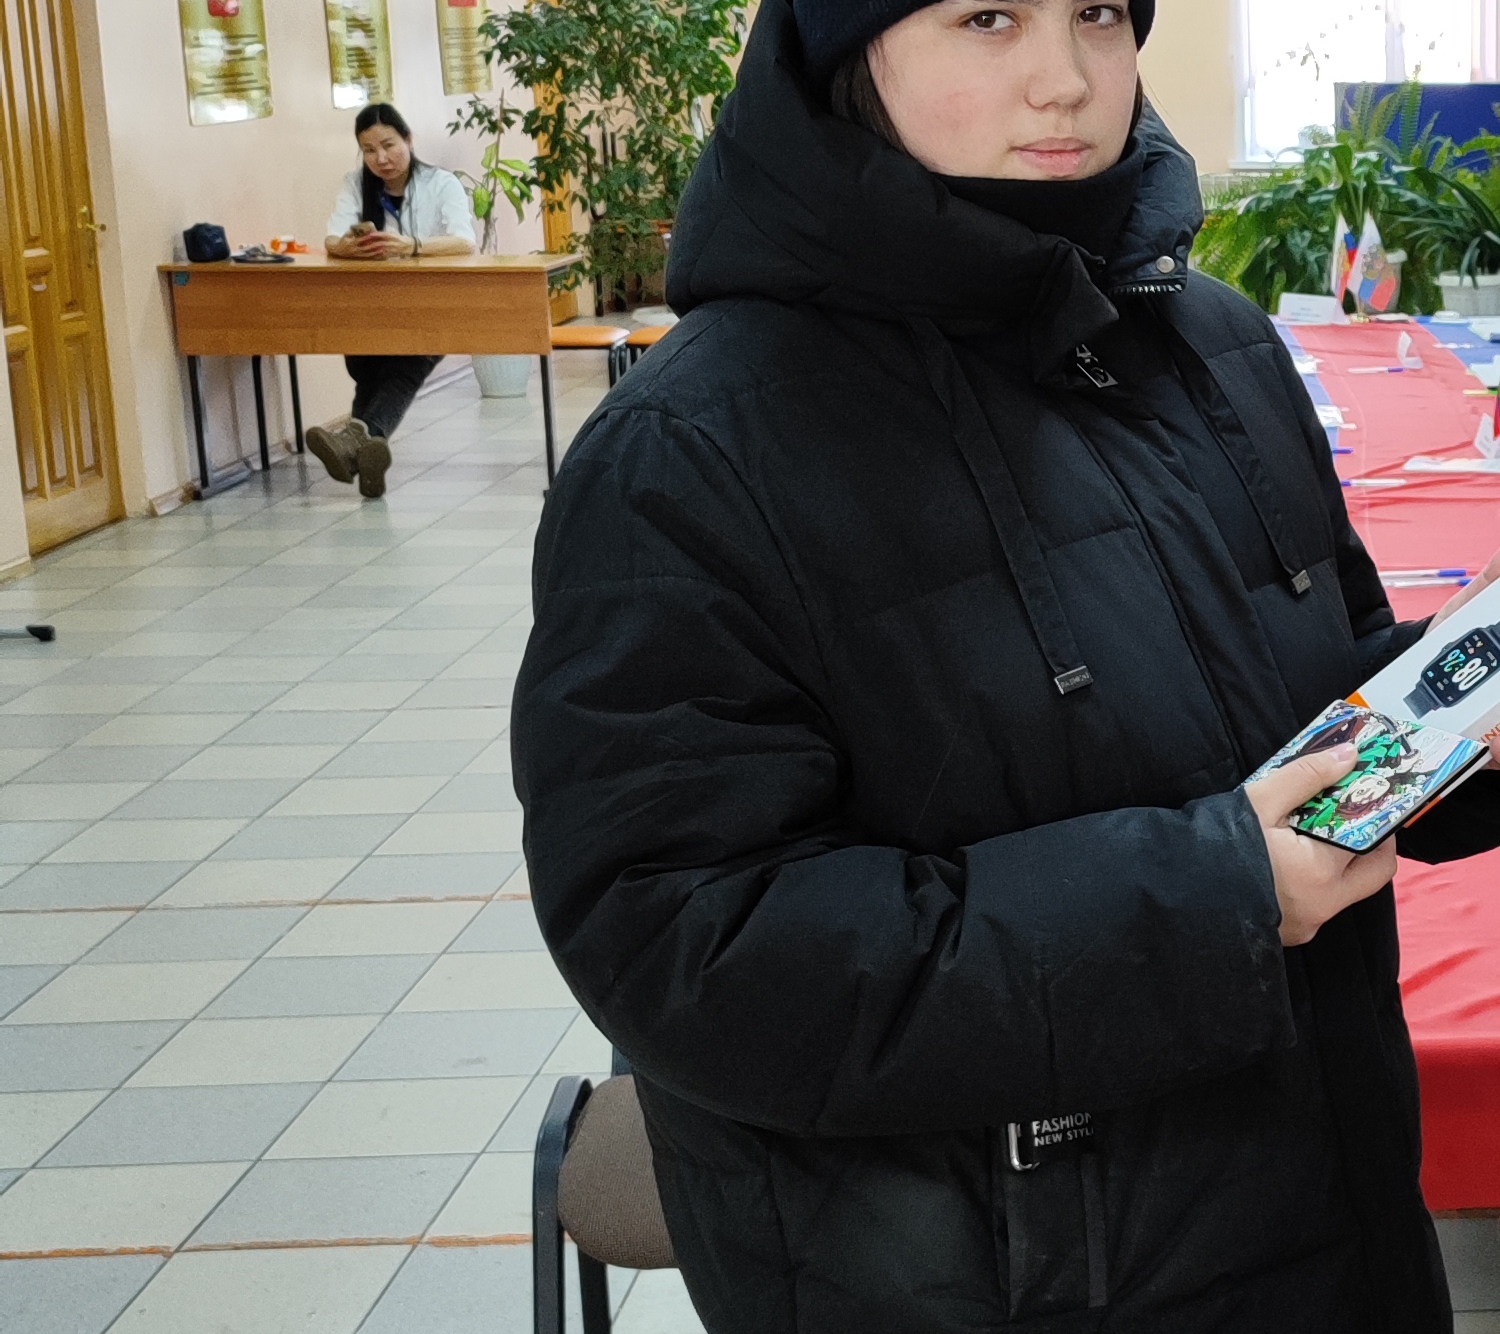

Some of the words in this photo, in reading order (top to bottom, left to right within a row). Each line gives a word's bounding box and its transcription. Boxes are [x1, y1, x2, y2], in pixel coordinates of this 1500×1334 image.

[1031, 1112, 1092, 1135] FASHION
[1034, 1132, 1063, 1147] NEW
[1066, 1126, 1095, 1141] STYL
